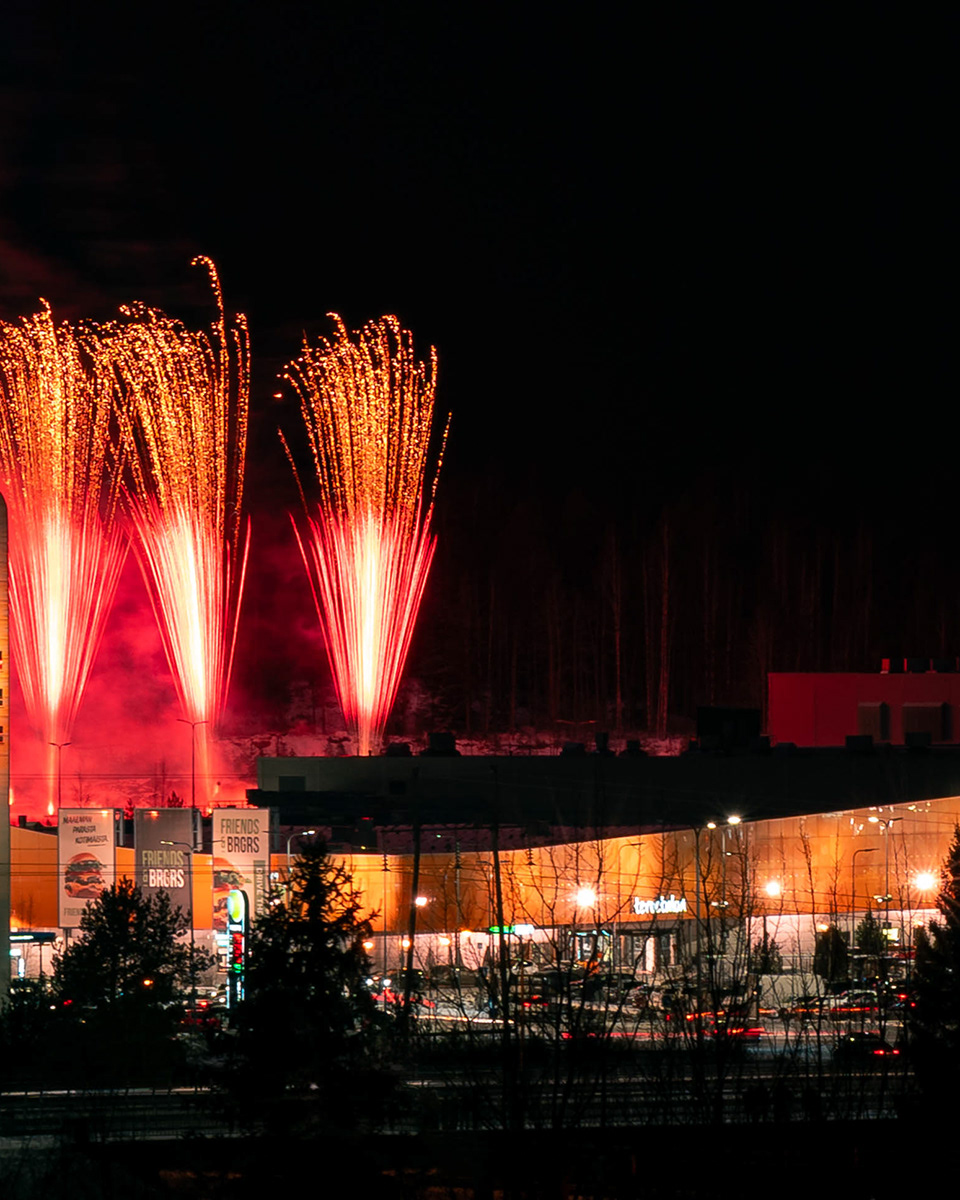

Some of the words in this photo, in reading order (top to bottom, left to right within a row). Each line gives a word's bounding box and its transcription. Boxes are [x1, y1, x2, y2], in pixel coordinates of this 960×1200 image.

[221, 819, 259, 834] FRIENDS
[227, 837, 259, 853] BRGRS
[142, 850, 184, 867] FRIENDS
[149, 869, 185, 888] BRGRS
